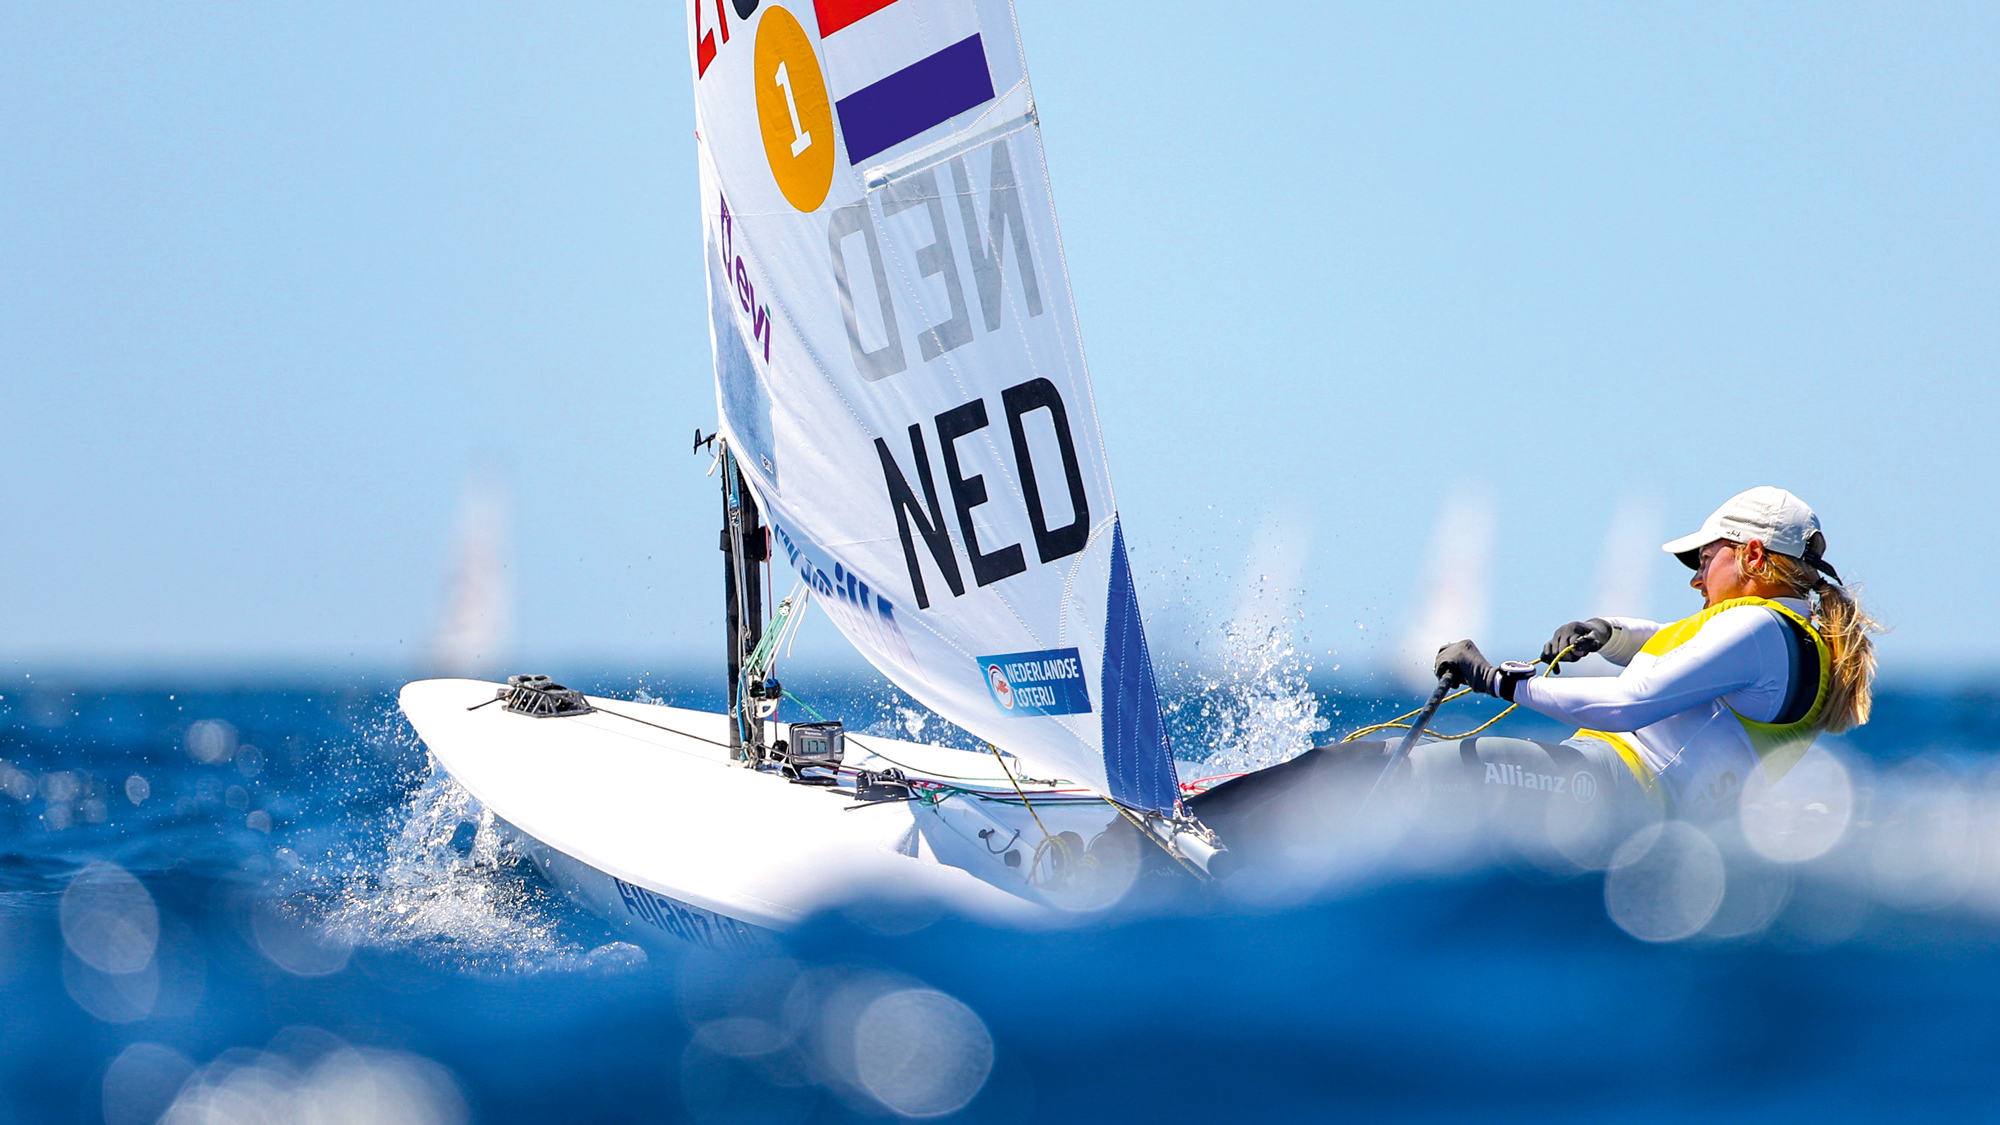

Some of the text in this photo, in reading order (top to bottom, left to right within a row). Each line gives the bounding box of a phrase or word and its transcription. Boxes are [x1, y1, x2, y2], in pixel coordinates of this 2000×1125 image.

[775, 61, 812, 158] 1
[874, 377, 1090, 610] NED
[1004, 657, 1080, 684] NEDERLANDSE
[1013, 685, 1056, 707] LOTERIJ
[1484, 762, 1566, 794] Allianz
